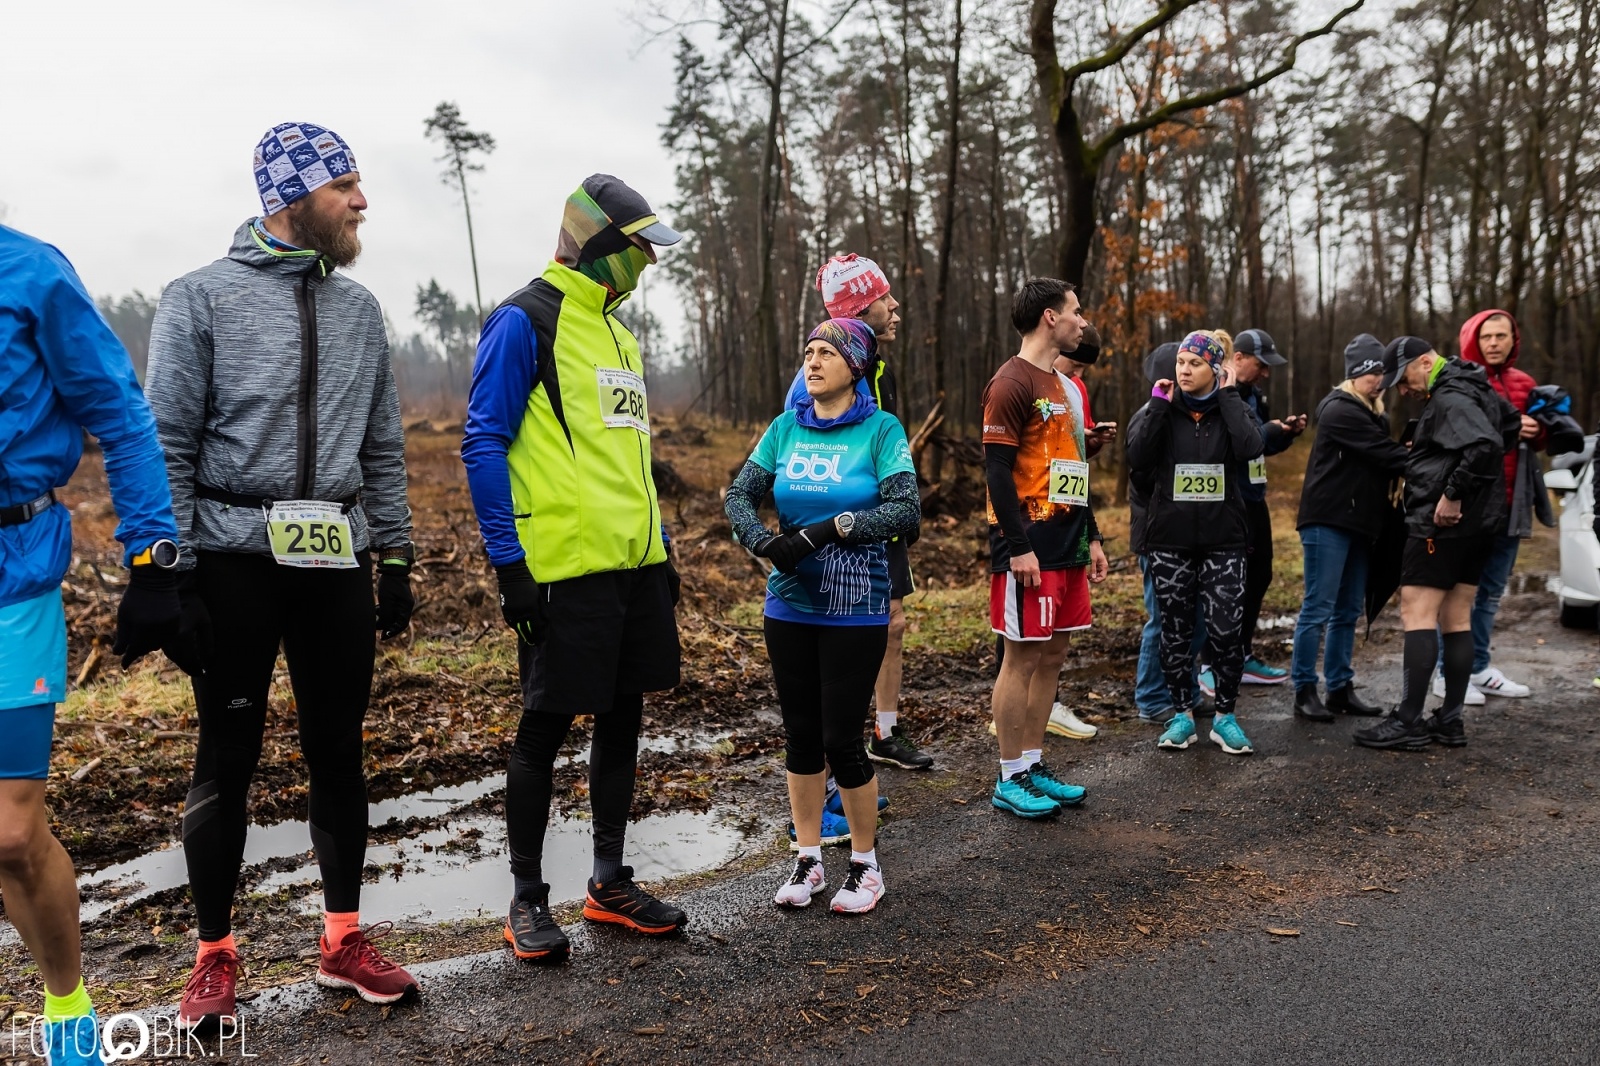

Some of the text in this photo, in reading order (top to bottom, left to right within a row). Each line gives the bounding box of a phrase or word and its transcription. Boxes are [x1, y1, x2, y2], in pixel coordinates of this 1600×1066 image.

[612, 387, 644, 421] 268
[786, 452, 842, 482] bbl
[789, 484, 829, 494] RACIBÓRZ
[1057, 474, 1085, 497] 272
[1181, 476, 1218, 493] 239
[284, 523, 342, 555] 256
[1038, 596, 1053, 627] 11
